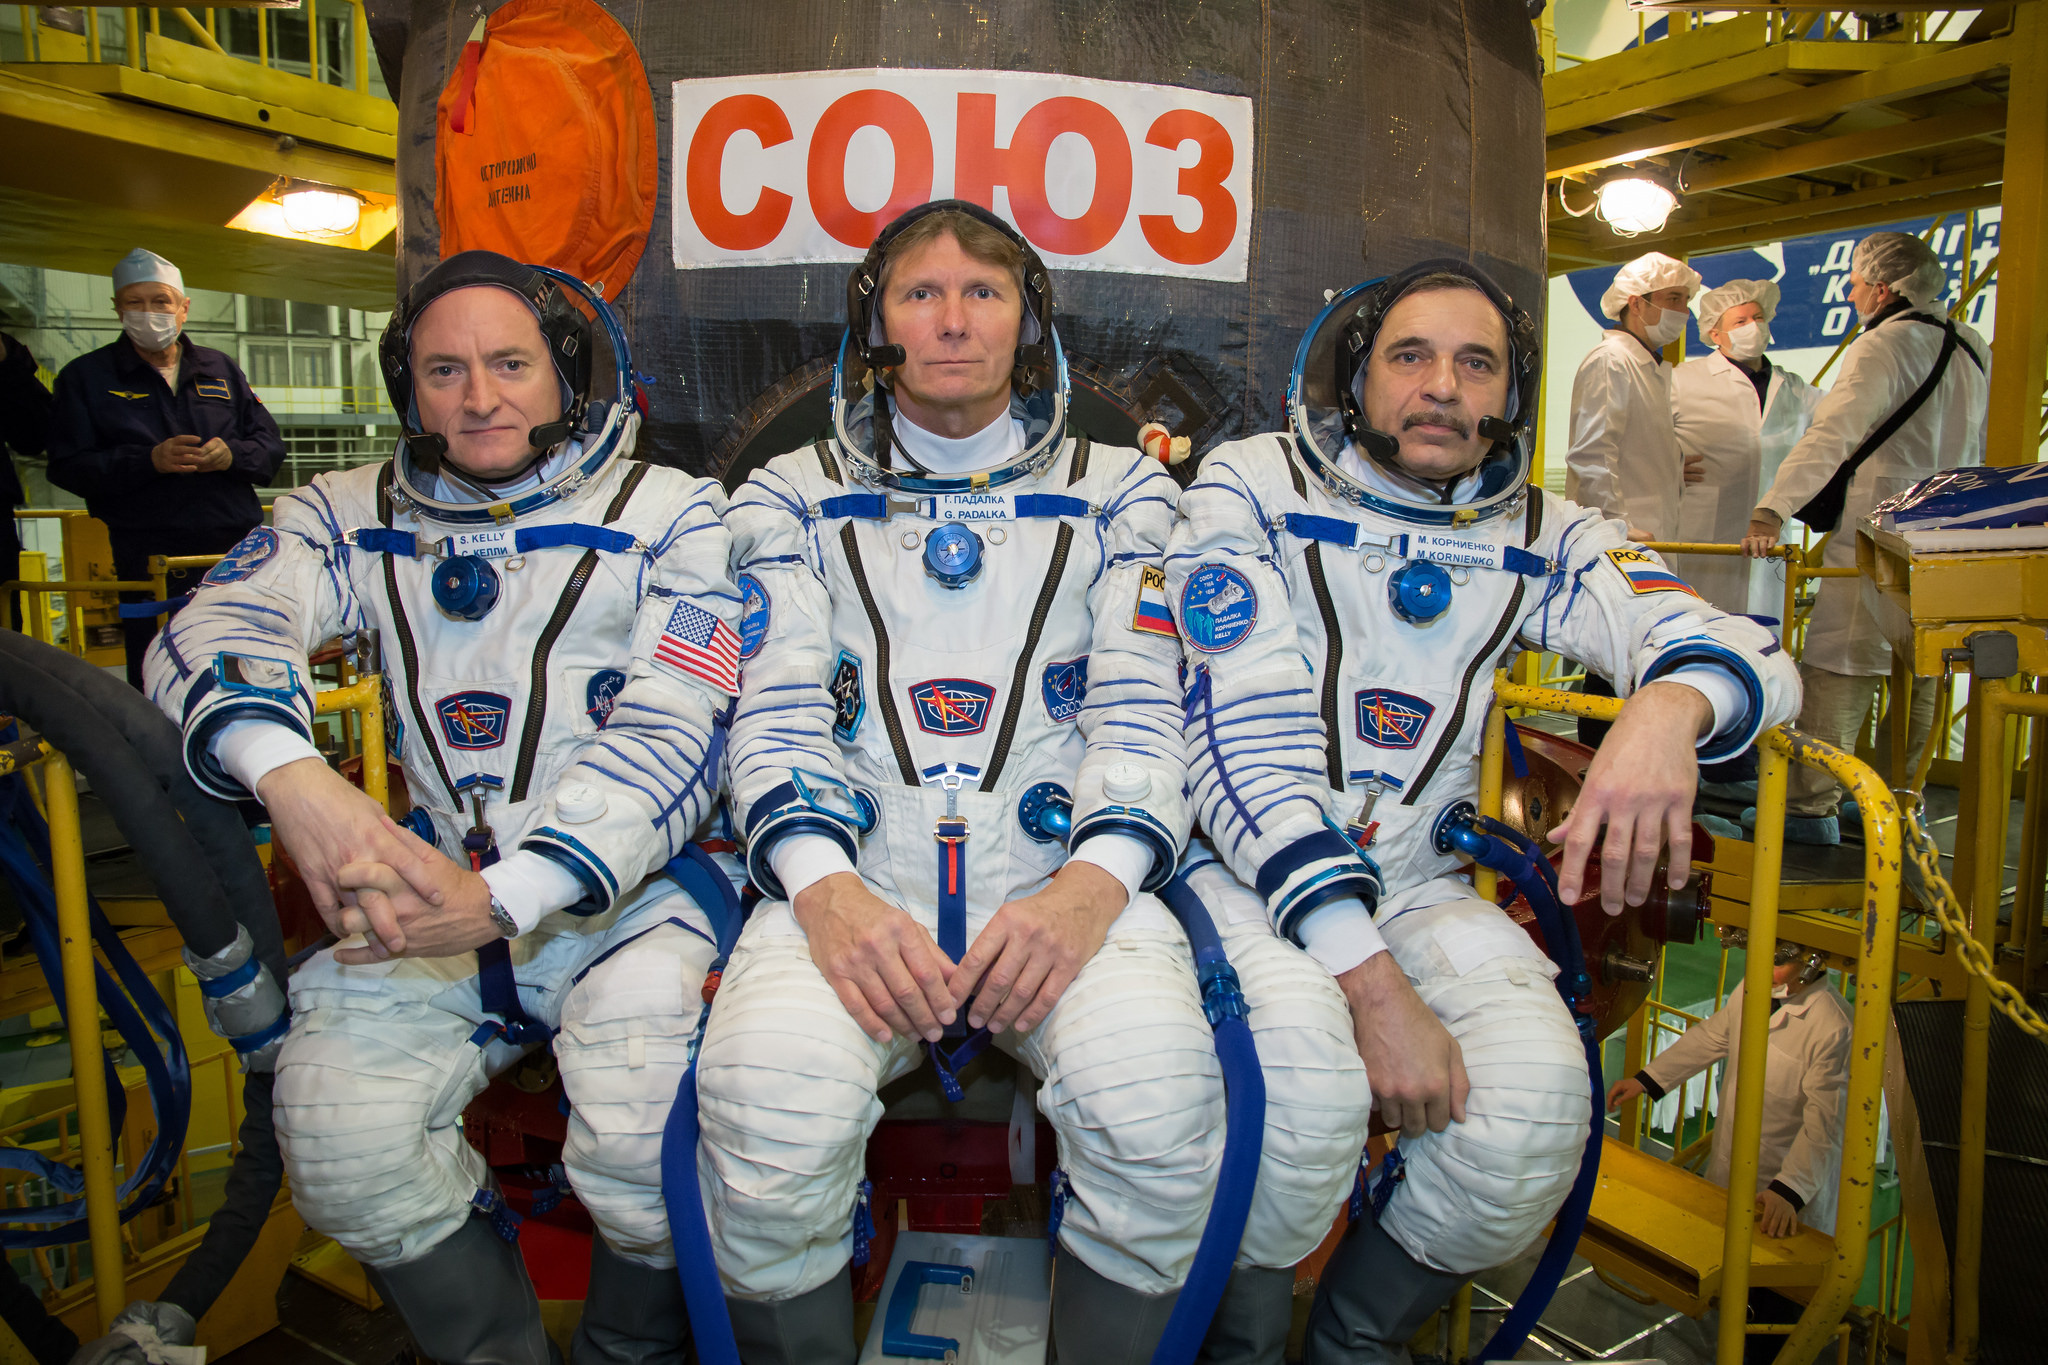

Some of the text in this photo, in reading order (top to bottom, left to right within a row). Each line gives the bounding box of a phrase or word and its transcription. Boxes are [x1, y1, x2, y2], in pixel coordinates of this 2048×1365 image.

[480, 152, 537, 182] ОСТОРОЖНО
[687, 89, 1237, 265] СОЮЗ
[488, 184, 531, 208] АНТЕННА
[954, 495, 1006, 506] ПАДАЛКА
[944, 510, 1007, 520] G. PADALKA
[460, 532, 506, 545] S. KELLY
[1417, 535, 1496, 553] М. КОРНИЕНКО
[1612, 551, 1652, 562] РОС
[1144, 570, 1166, 591] РОС
[1214, 631, 1232, 640] KELLY
